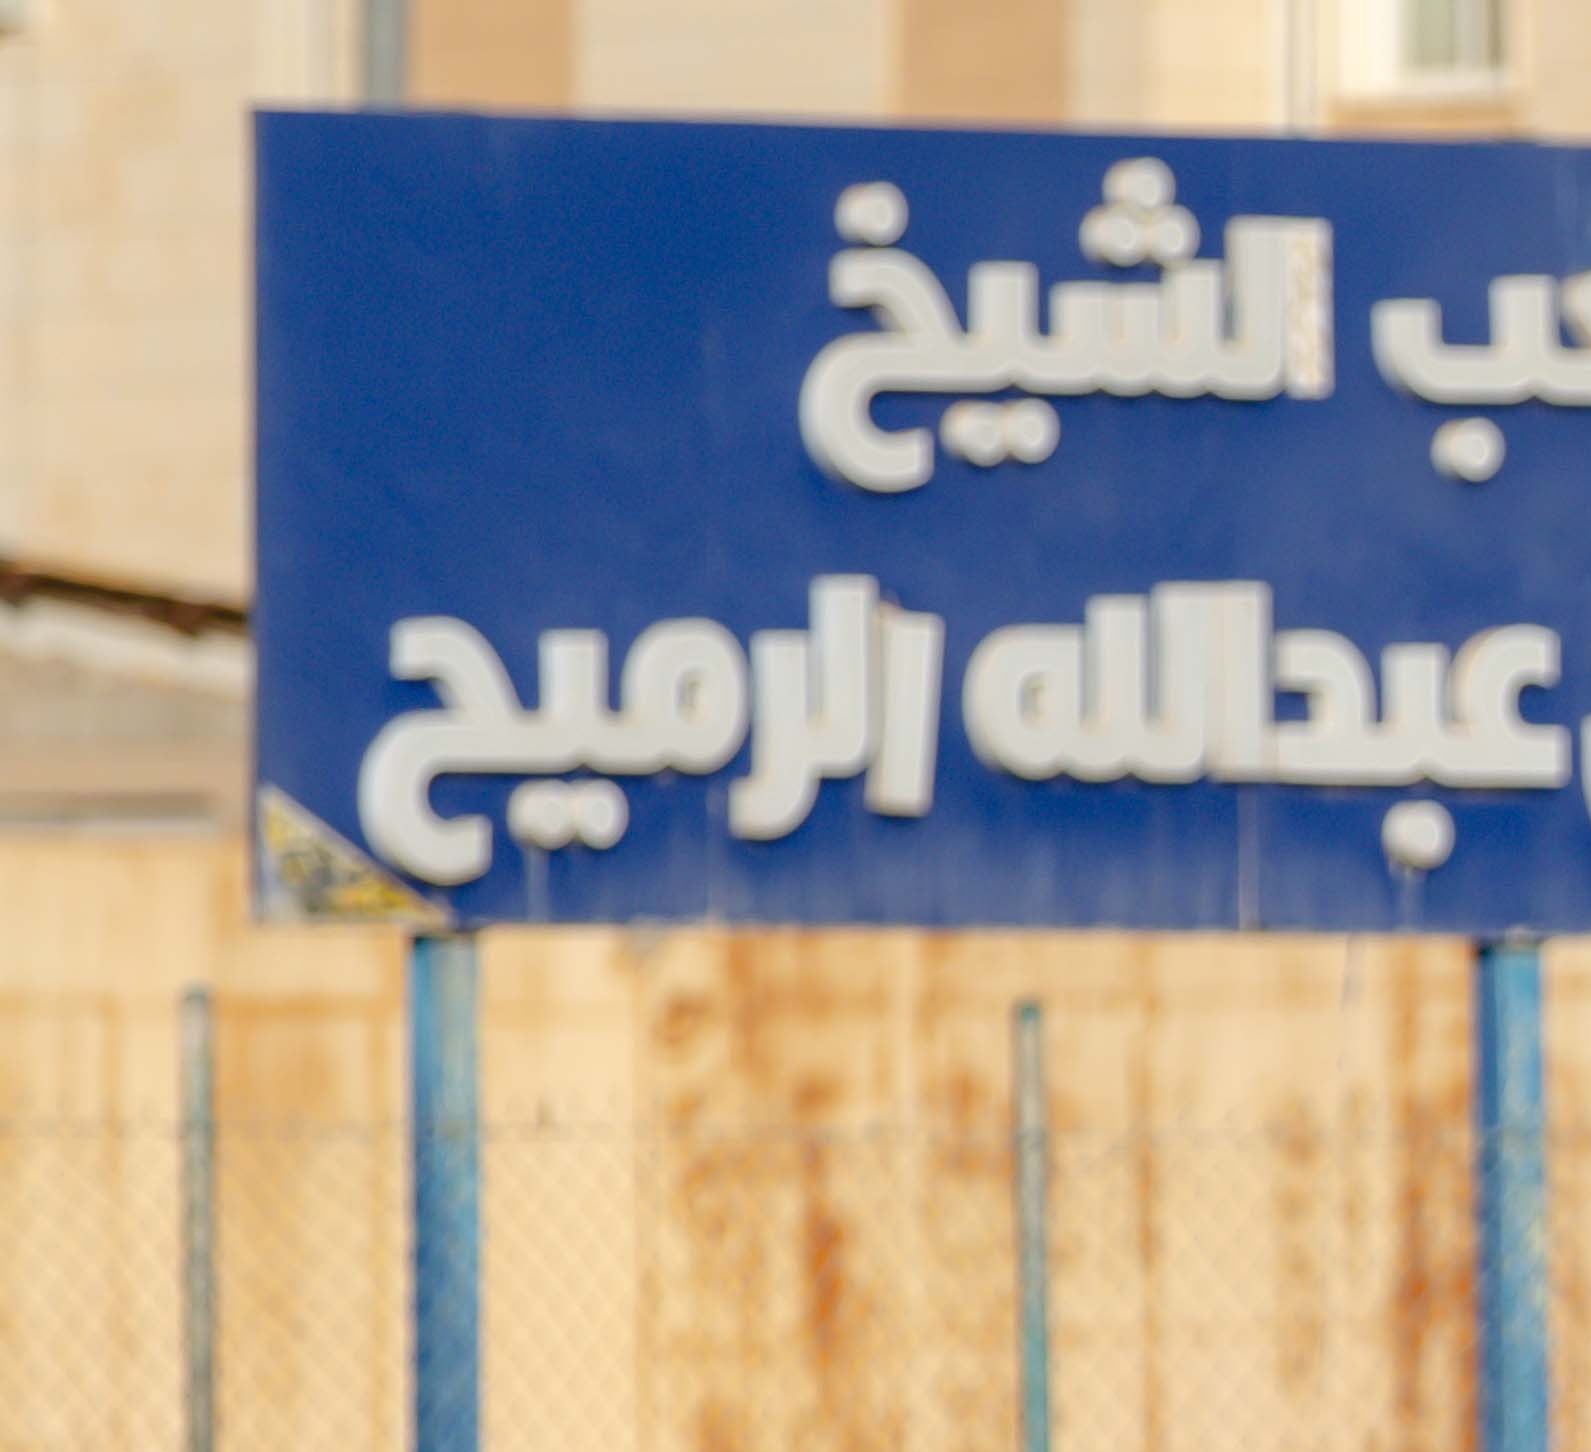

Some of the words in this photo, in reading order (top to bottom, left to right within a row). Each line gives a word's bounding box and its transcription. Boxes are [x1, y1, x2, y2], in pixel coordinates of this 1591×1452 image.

[802, 161, 1332, 488] الشيخ
[361, 576, 942, 882] الرميح
[964, 582, 1569, 866] عبدالله
